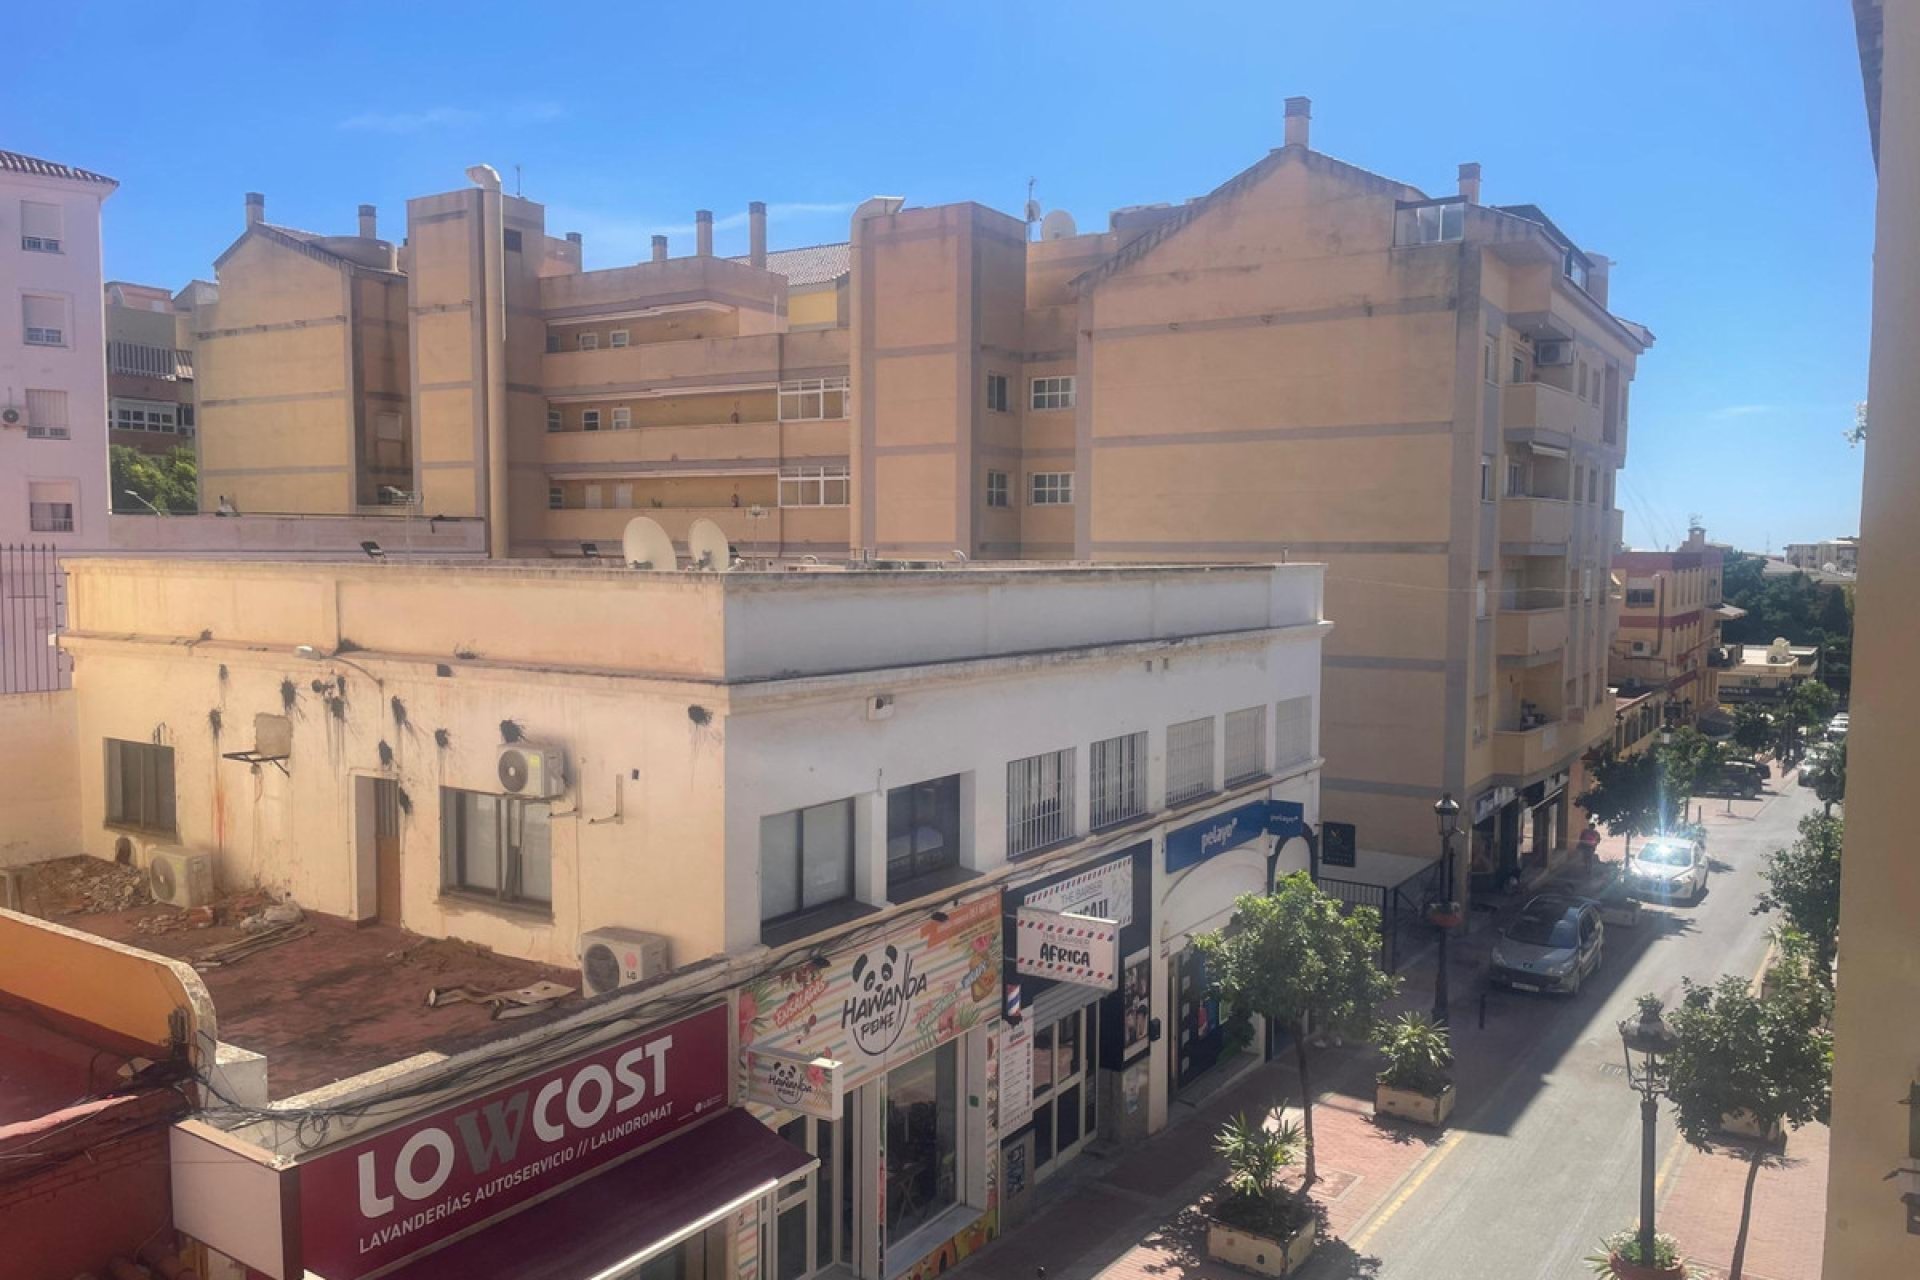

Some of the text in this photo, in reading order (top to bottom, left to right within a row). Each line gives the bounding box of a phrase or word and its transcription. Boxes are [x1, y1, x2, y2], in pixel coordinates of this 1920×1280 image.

[1201, 822, 1234, 855] pelayo
[1040, 942, 1090, 968] AFRICA
[626, 970, 638, 981] LG
[357, 1034, 673, 1219] LOWCOST
[359, 1191, 471, 1254] LAVANDERÍAS
[474, 1146, 574, 1204] AUTOSERVICIO
[591, 1101, 673, 1150] LAUNDROMAT
